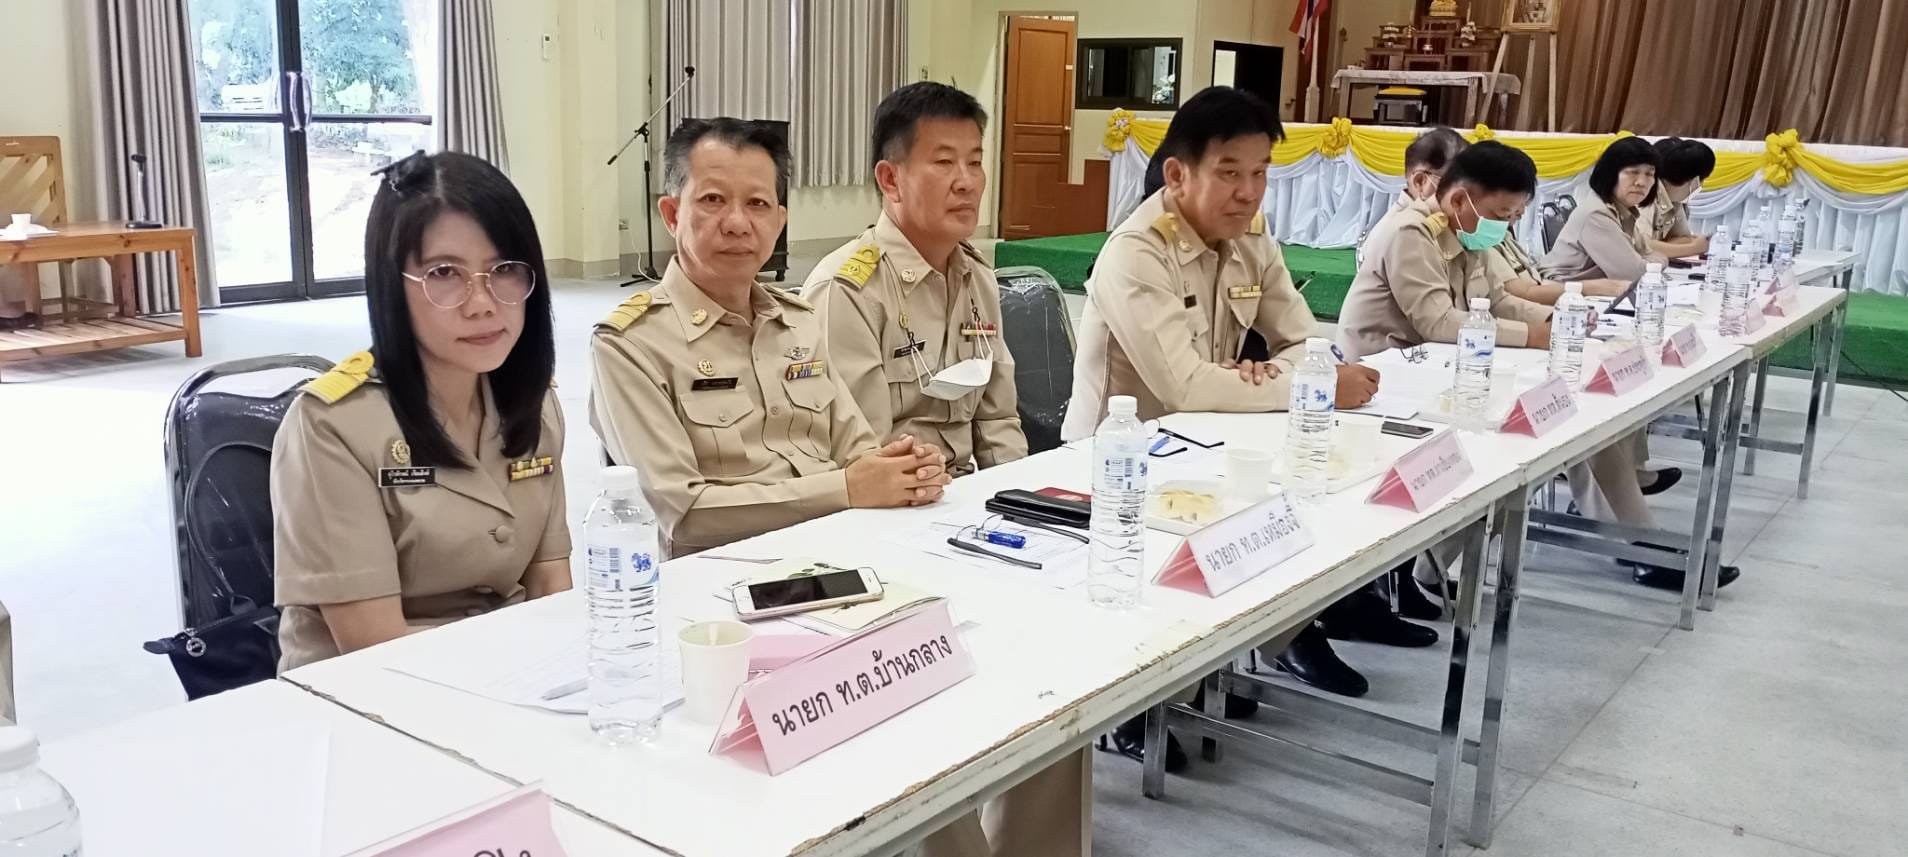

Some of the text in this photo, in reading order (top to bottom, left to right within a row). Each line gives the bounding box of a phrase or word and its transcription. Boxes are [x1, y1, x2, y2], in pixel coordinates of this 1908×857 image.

[1205, 543, 1241, 572] นายก
[772, 634, 953, 735] นายก ท.ต.บ้านกลาง
